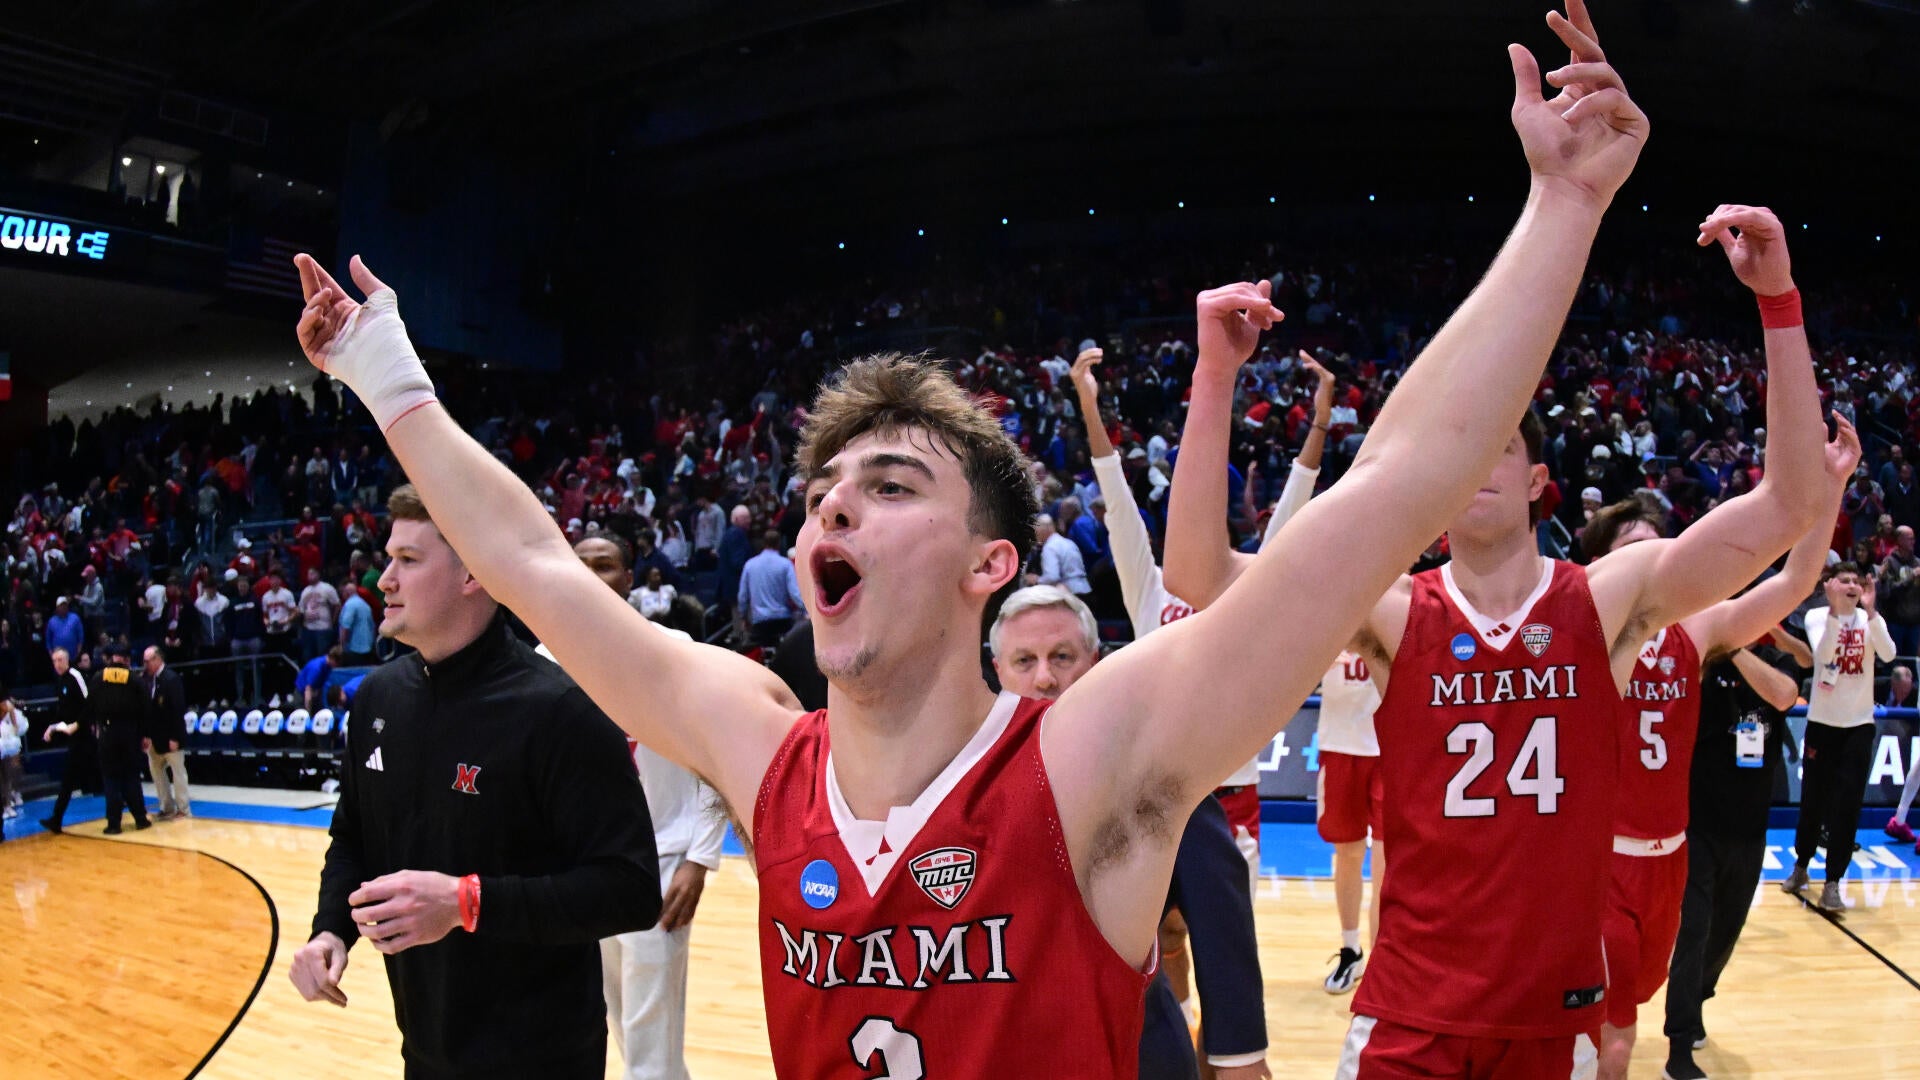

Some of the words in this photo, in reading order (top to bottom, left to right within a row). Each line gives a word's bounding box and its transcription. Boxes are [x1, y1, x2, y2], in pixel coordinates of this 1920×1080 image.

[0, 215, 71, 256] OUR
[1524, 634, 1550, 644] MAC
[1429, 665, 1579, 706] MIAMI
[1639, 710, 1668, 770] 5
[451, 762, 482, 795] M
[1443, 716, 1565, 818] 24
[804, 880, 836, 898] NCAA
[917, 865, 974, 888] MAC
[772, 914, 1018, 991] MIAMI
